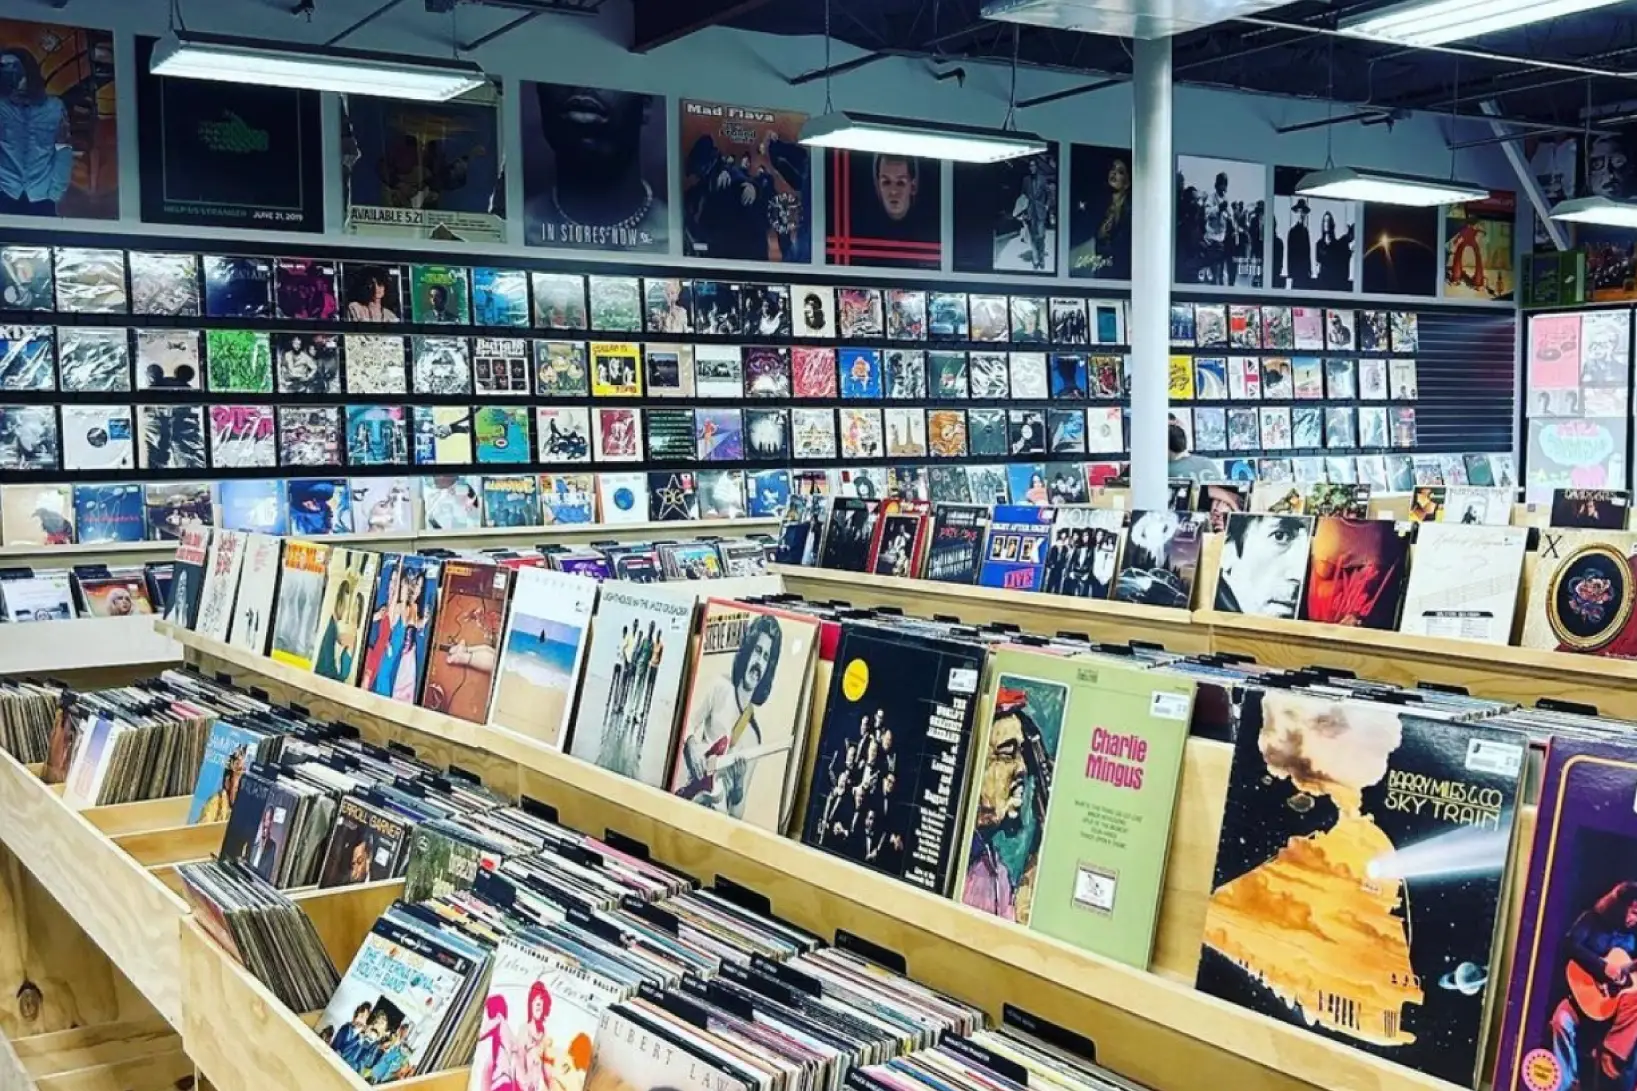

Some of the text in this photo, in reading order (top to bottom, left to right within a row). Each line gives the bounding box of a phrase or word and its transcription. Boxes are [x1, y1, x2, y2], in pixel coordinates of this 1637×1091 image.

[687, 103, 775, 122] Mad Flava
[253, 211, 273, 220] JUNE
[352, 207, 402, 223] AVAILABLE
[405, 211, 424, 224] 5.21
[542, 222, 554, 241] IN
[560, 223, 606, 244] STORES
[612, 227, 637, 245] NOW
[1541, 534, 1562, 559] X
[1092, 727, 1148, 763] Charlie
[1085, 753, 1144, 790] Mingus
[1388, 769, 1432, 796] BARRY
[1479, 788, 1503, 809] CO
[341, 800, 403, 840] ERROLL GARNER
[1384, 792, 1500, 832] SKY TRAIN
[600, 1014, 676, 1066] HUBERT
